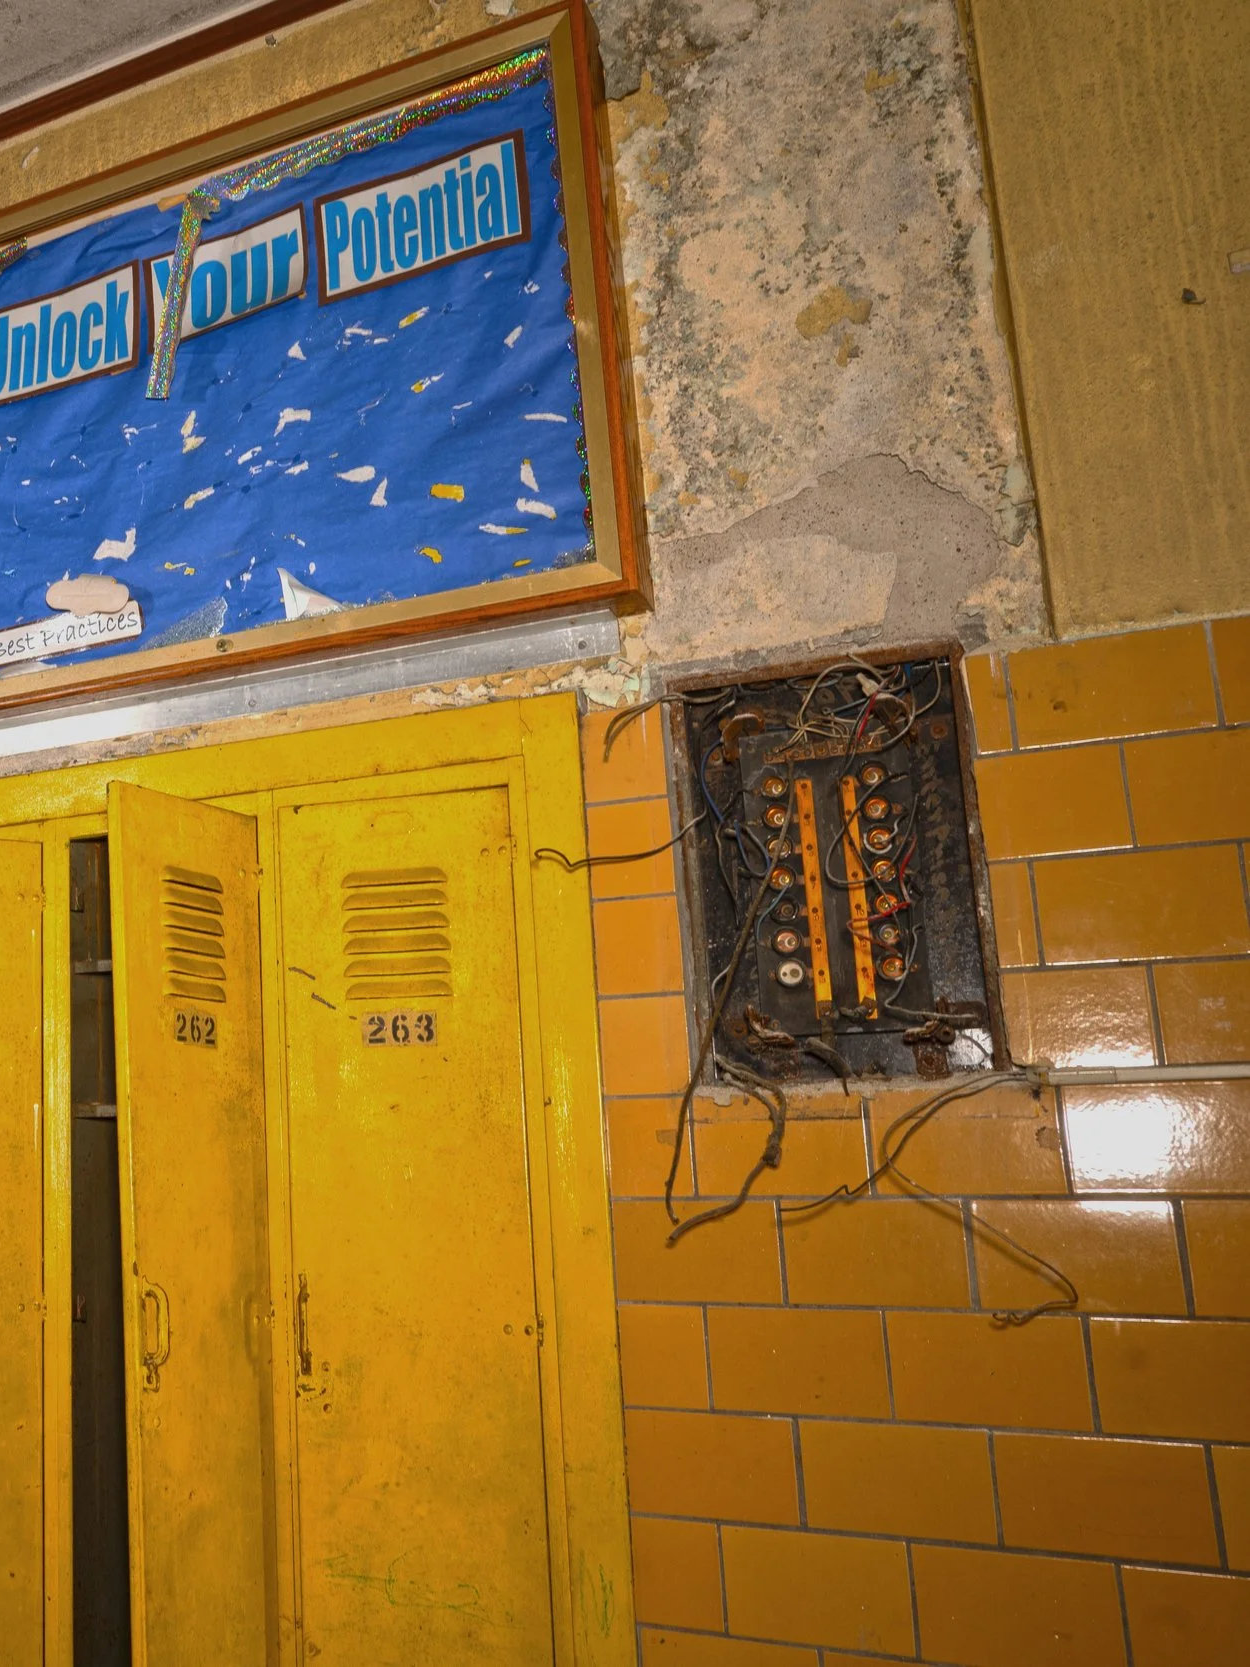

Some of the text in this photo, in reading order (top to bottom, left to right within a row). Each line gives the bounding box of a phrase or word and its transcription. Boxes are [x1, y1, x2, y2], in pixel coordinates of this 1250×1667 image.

[325, 140, 522, 291] Potential
[40, 611, 138, 647] Practices
[176, 1012, 216, 1044] 262
[367, 1013, 436, 1044] 263
